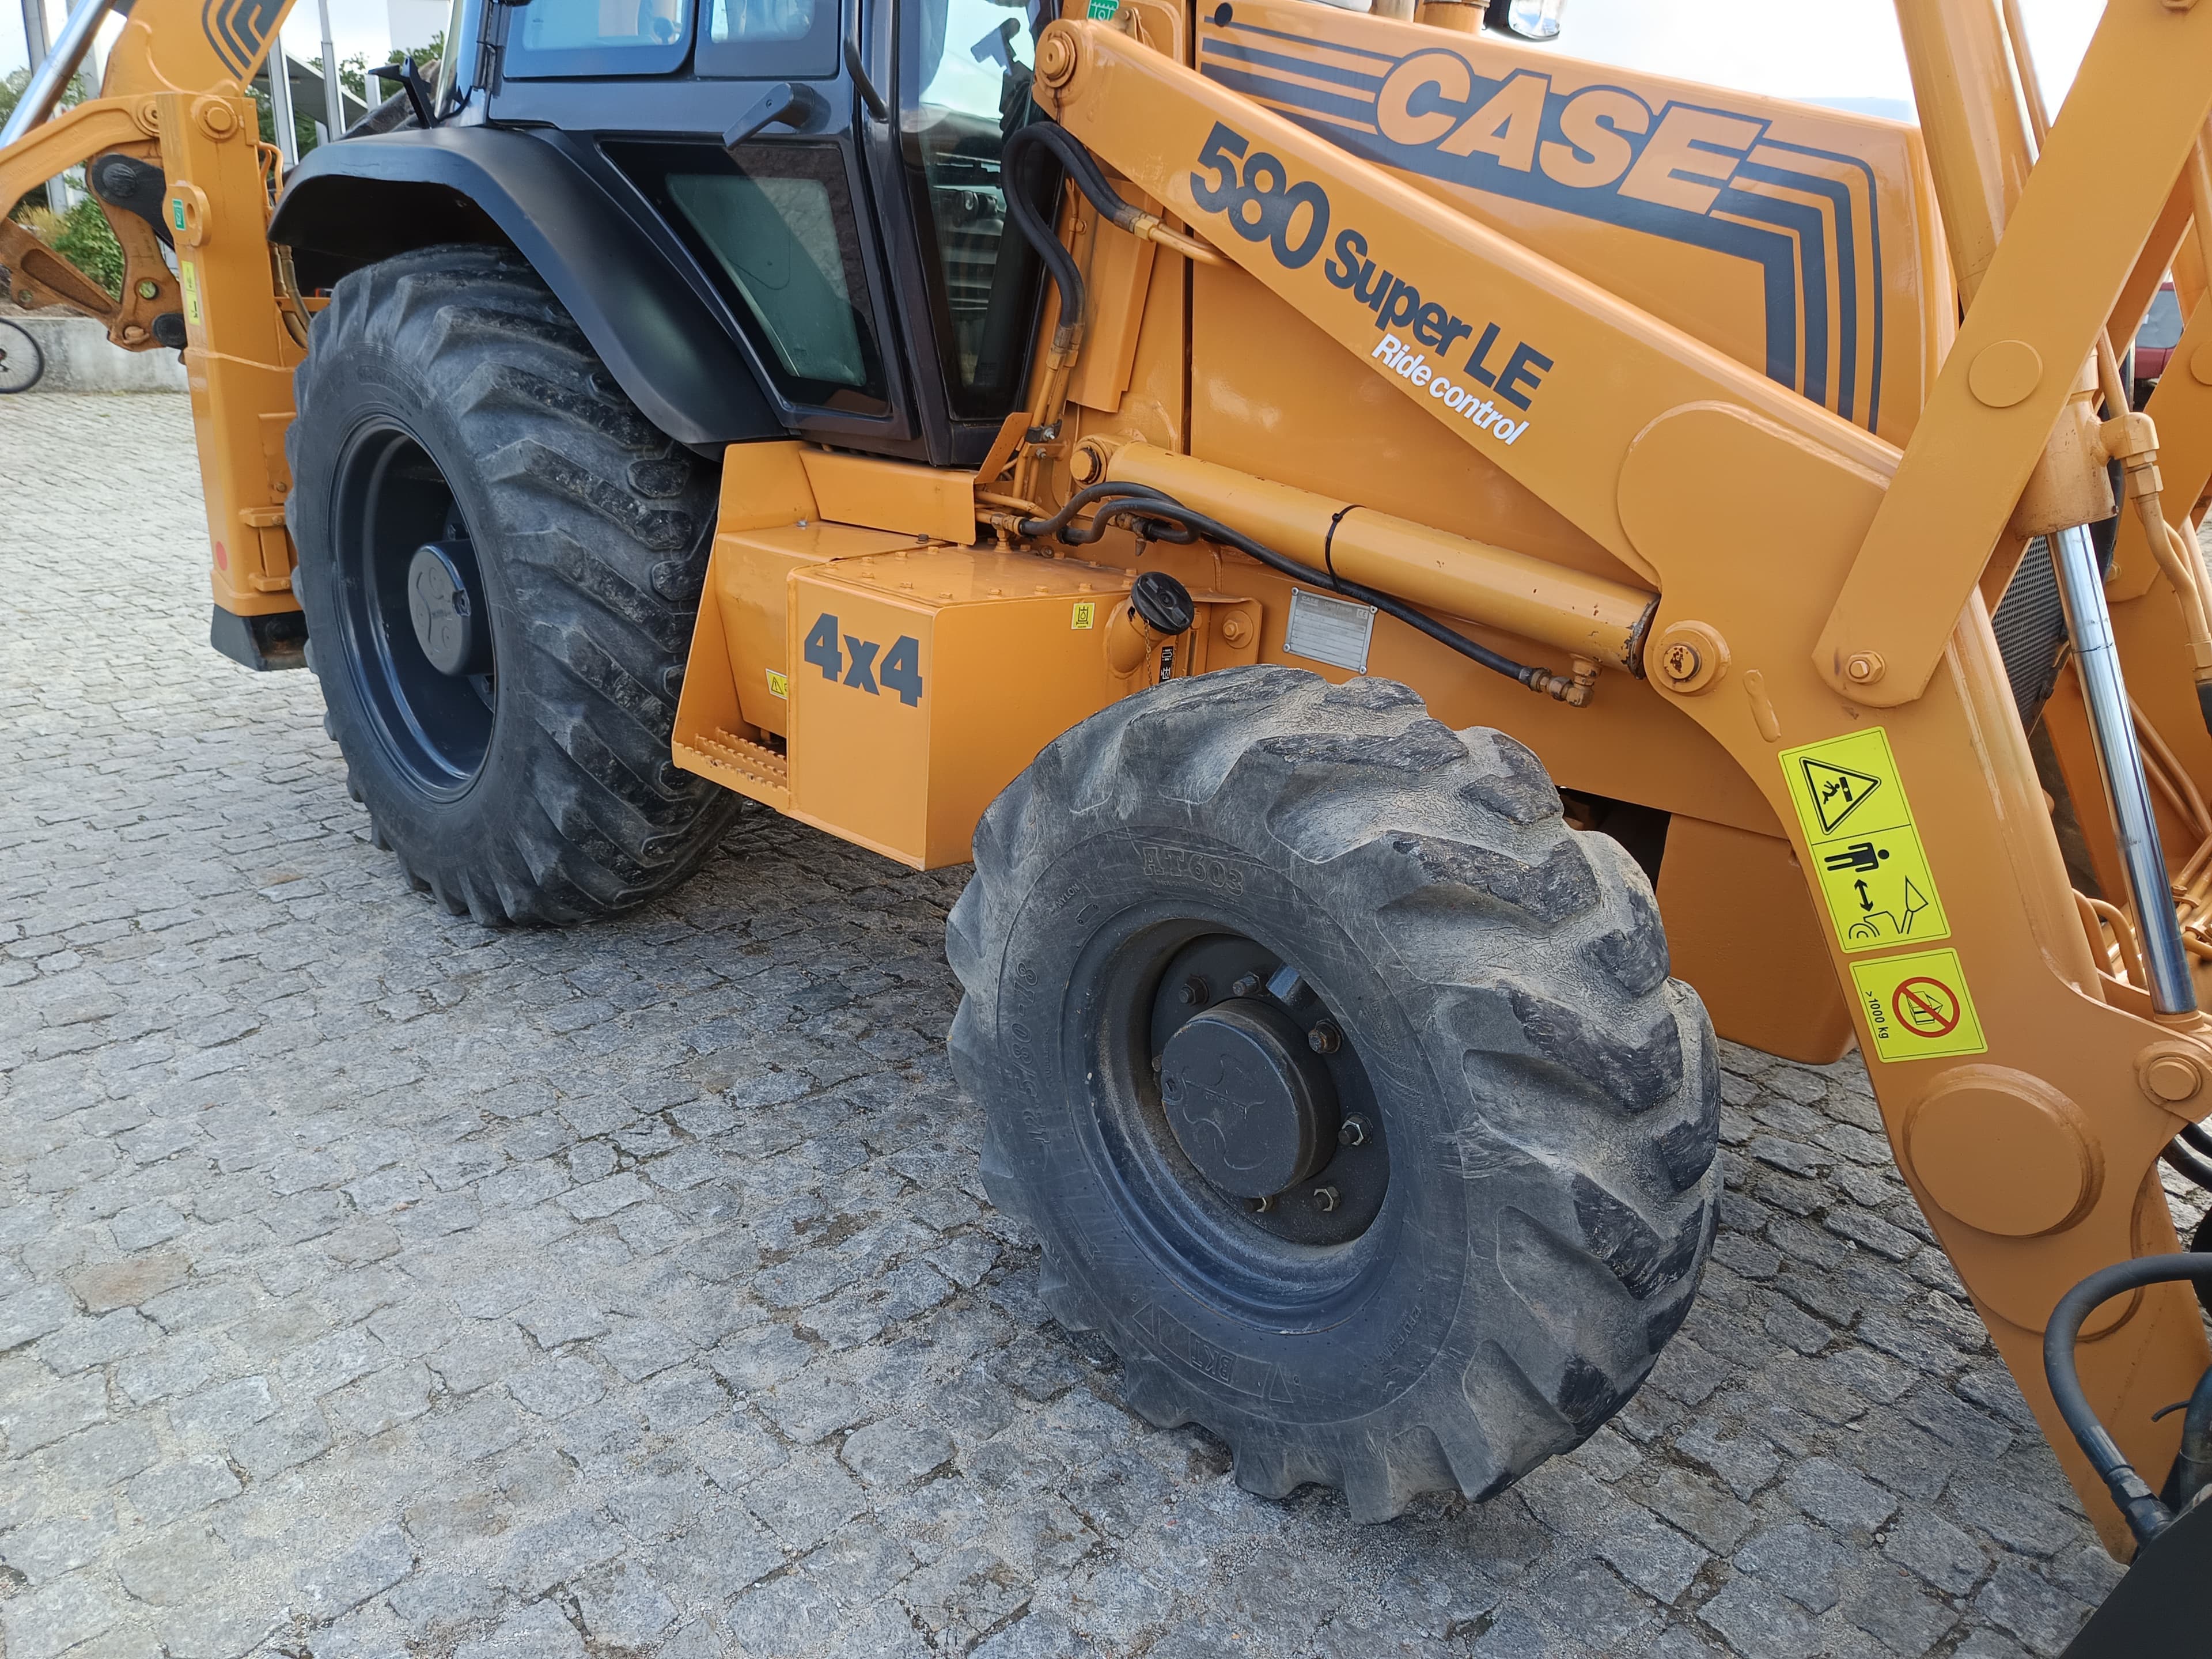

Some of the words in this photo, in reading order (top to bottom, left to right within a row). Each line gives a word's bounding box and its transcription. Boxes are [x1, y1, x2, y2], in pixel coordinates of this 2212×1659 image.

[1376, 52, 1764, 217] CASE
[1191, 121, 1330, 269] 580
[1324, 229, 1473, 356] Super
[1464, 322, 1554, 411] LE
[1371, 332, 1433, 387] Ride
[1429, 376, 1530, 445] control
[1301, 595, 1319, 605] CASE
[804, 612, 923, 708] 4x4
[1056, 883, 1081, 909] NYLON
[1142, 847, 1245, 896] AT603
[1877, 1026, 1889, 1039] kg
[1191, 1337, 1234, 1382] BKT
